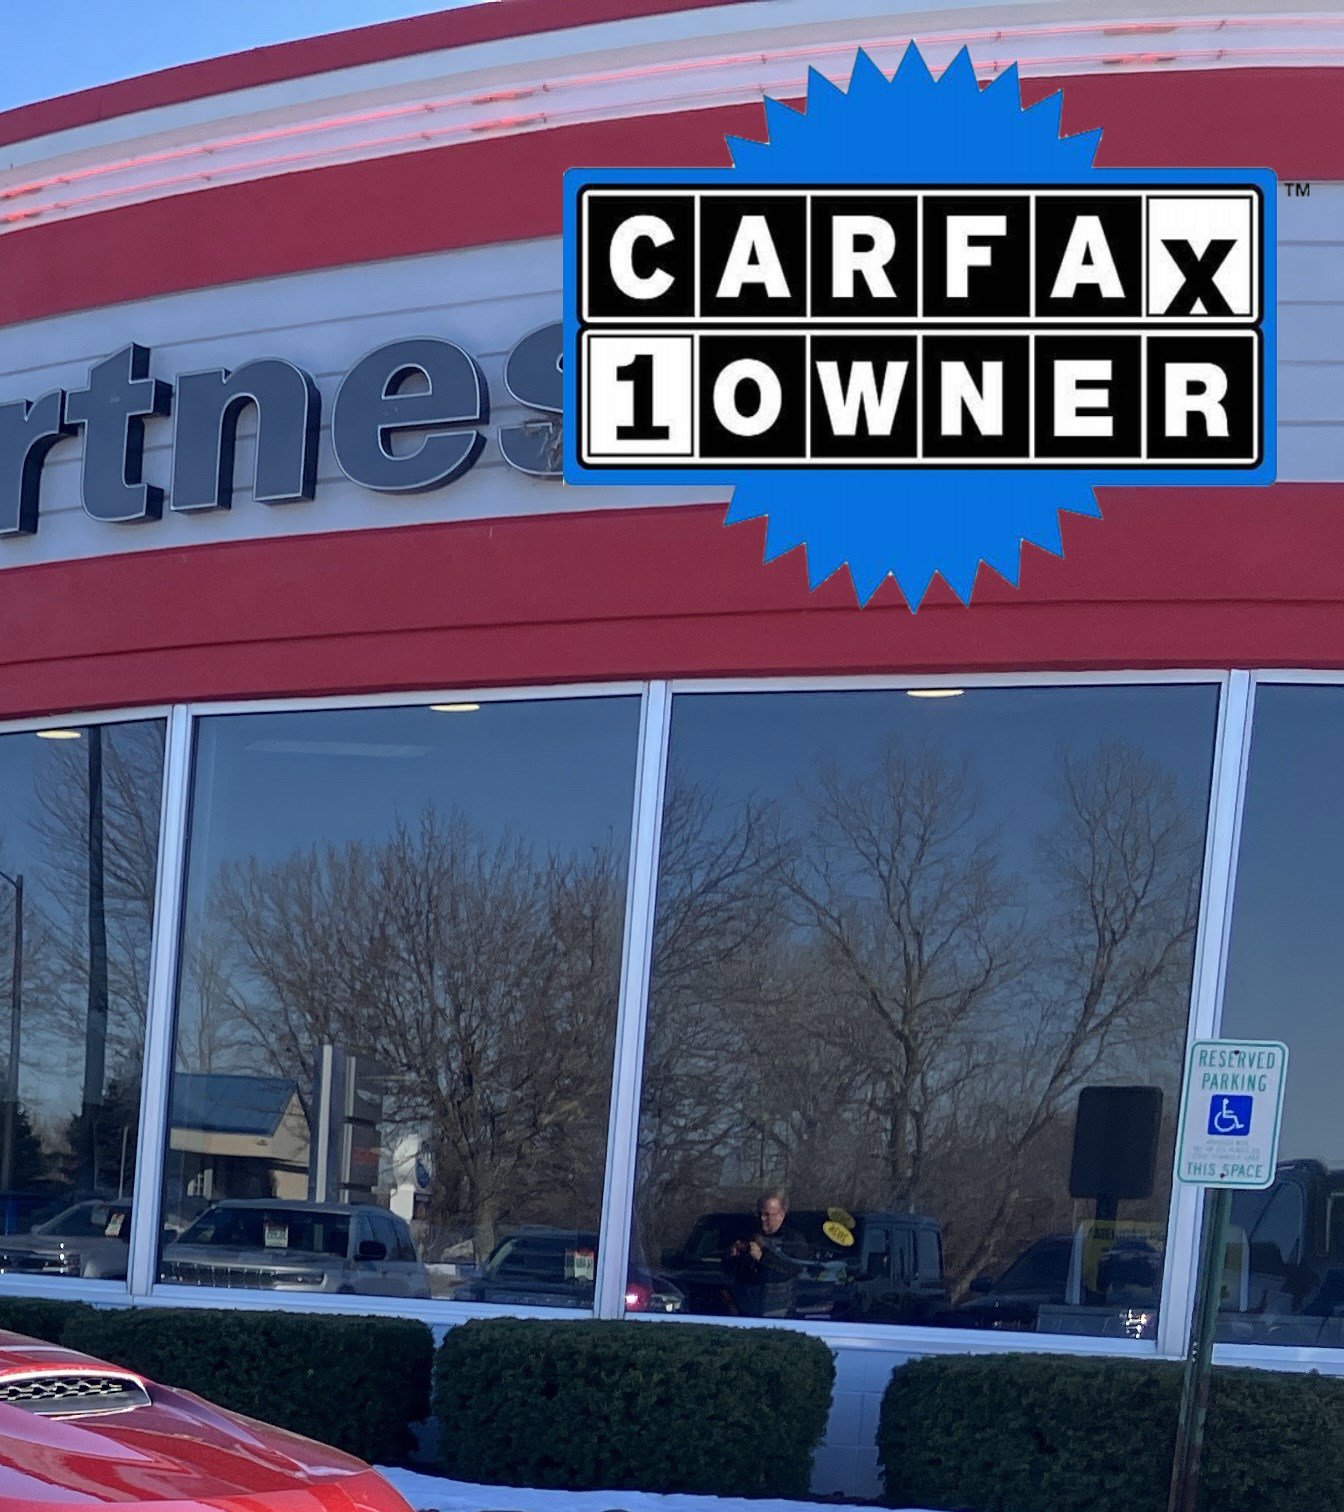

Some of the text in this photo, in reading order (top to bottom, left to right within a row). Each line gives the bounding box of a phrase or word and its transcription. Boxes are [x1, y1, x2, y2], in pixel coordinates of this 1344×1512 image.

[1199, 1050, 1275, 1069] RESERVED
[1202, 1072, 1267, 1092] PARKING
[1187, 1161, 1263, 1178] THIS SPACE
